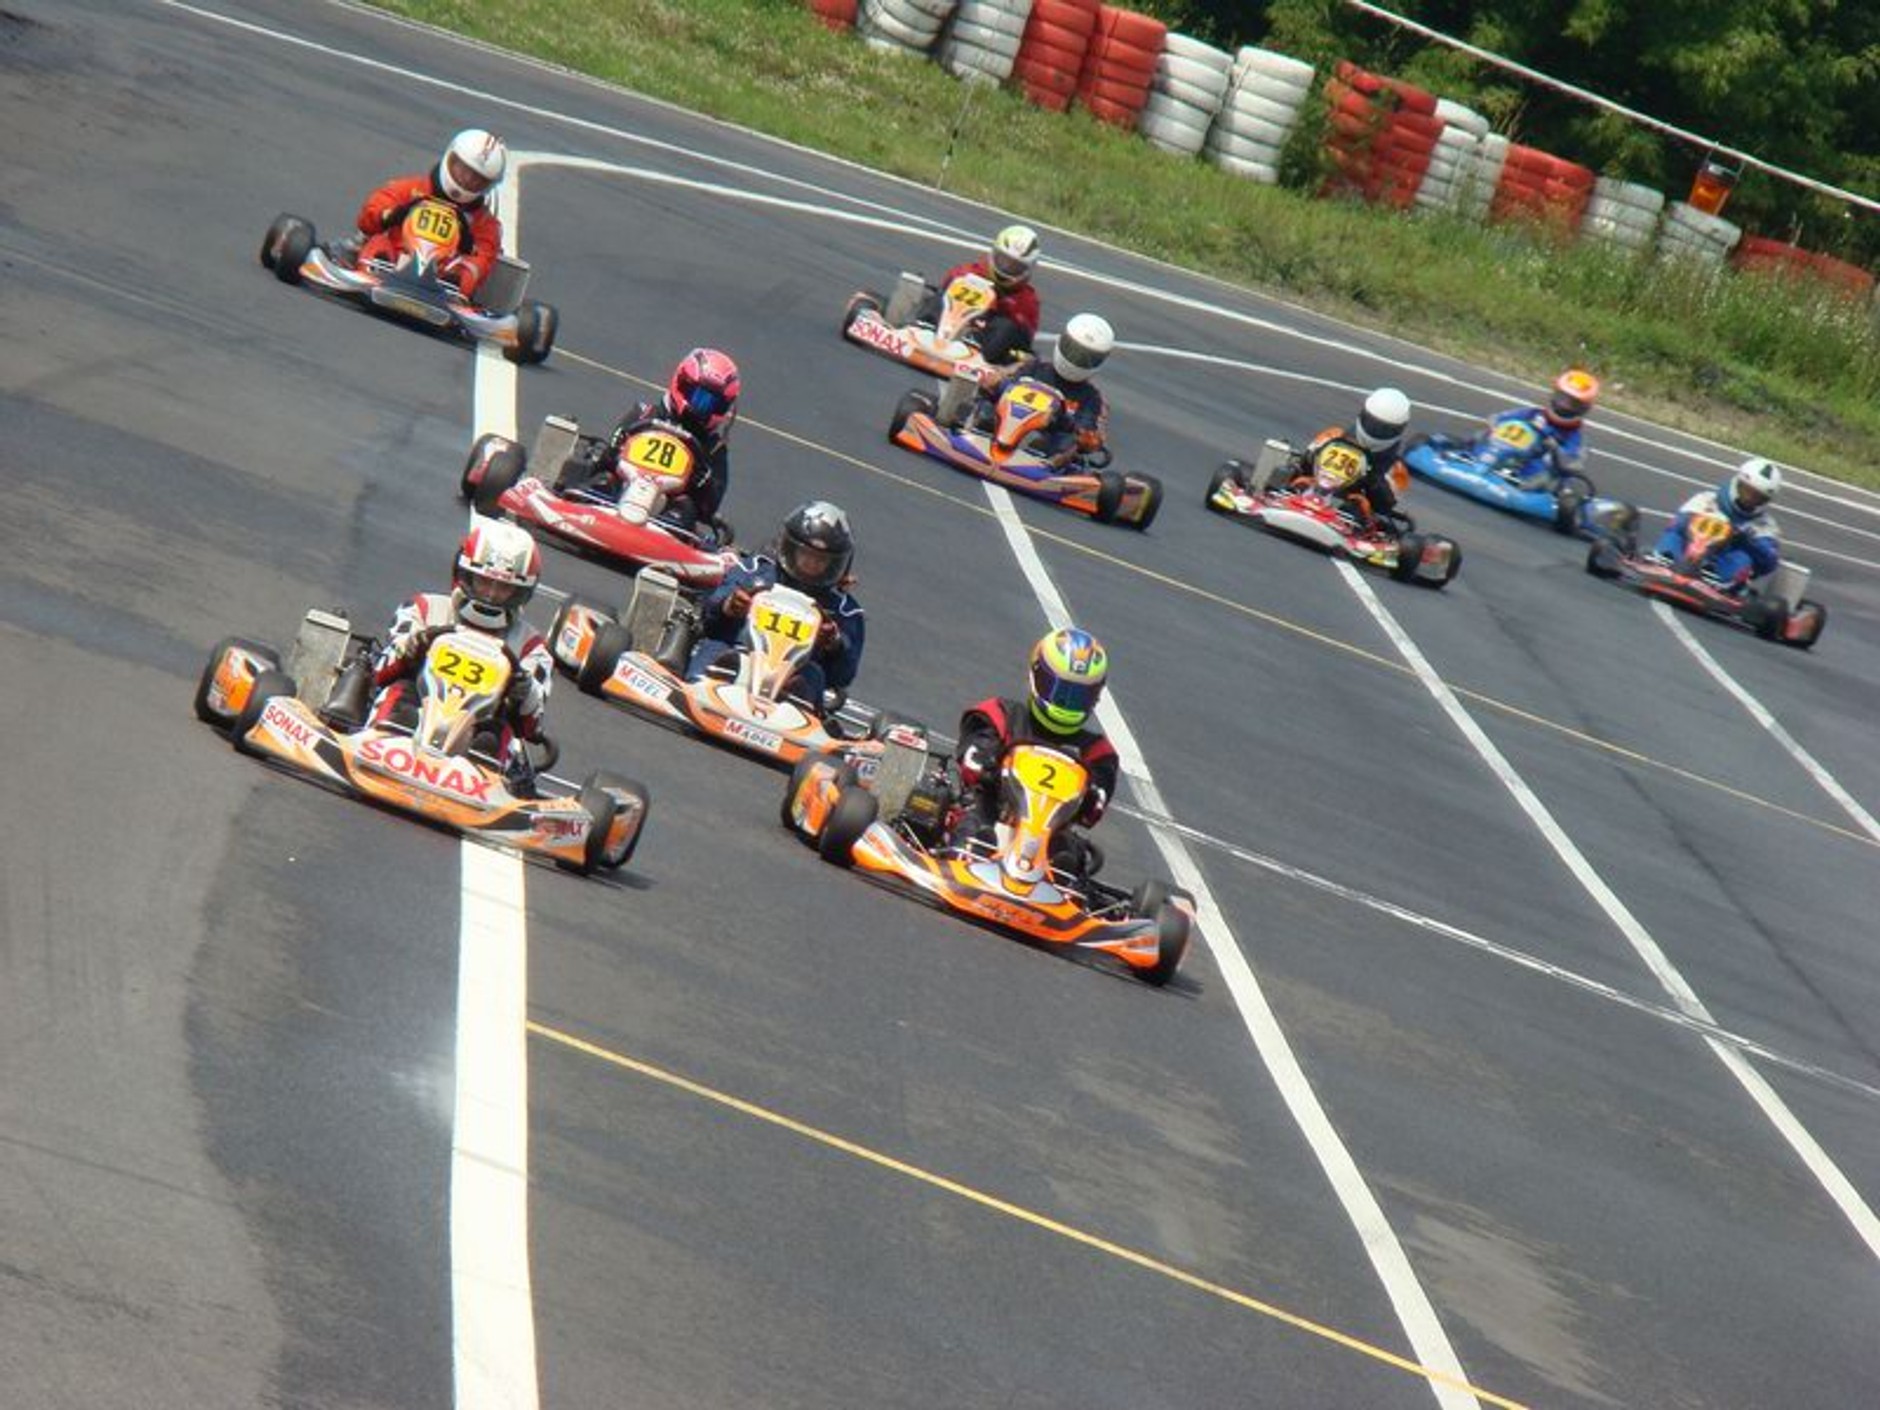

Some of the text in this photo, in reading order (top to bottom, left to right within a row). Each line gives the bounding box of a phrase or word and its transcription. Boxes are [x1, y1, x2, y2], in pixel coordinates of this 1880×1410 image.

[417, 208, 452, 239] 615
[1022, 392, 1038, 404] 4
[642, 437, 676, 469] 28
[763, 611, 803, 642] 11
[437, 651, 486, 685] 23
[264, 704, 314, 746] SONAX
[358, 739, 491, 803] SONAX
[1038, 763, 1057, 791] 2
